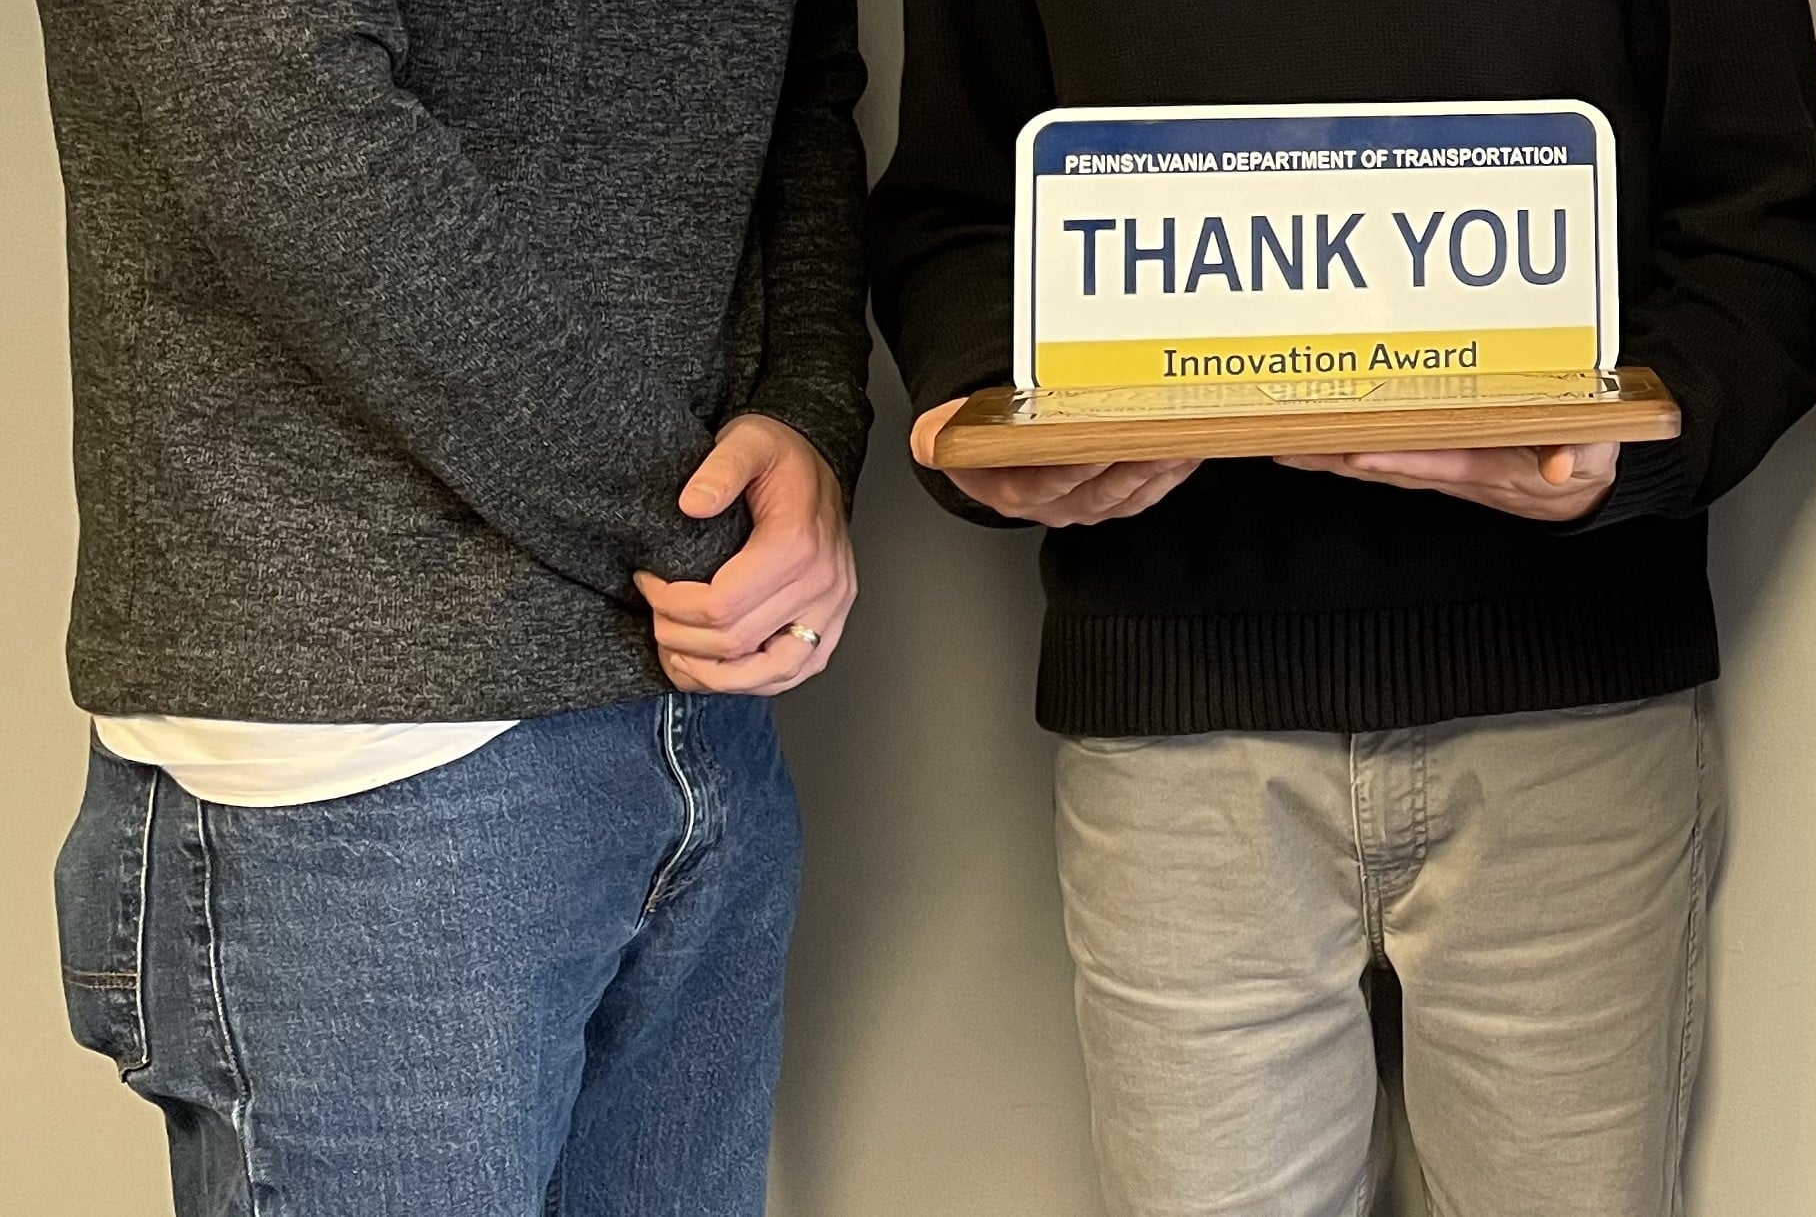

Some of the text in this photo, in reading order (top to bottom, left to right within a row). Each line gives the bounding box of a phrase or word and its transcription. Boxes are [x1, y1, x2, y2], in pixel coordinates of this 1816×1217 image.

[1064, 146, 1568, 175] PENNSYLVANIA DEPARTMENT OF TRANSPORTATION
[1063, 208, 1568, 296] THANK YOU
[1163, 341, 1477, 378] Innovation Award
